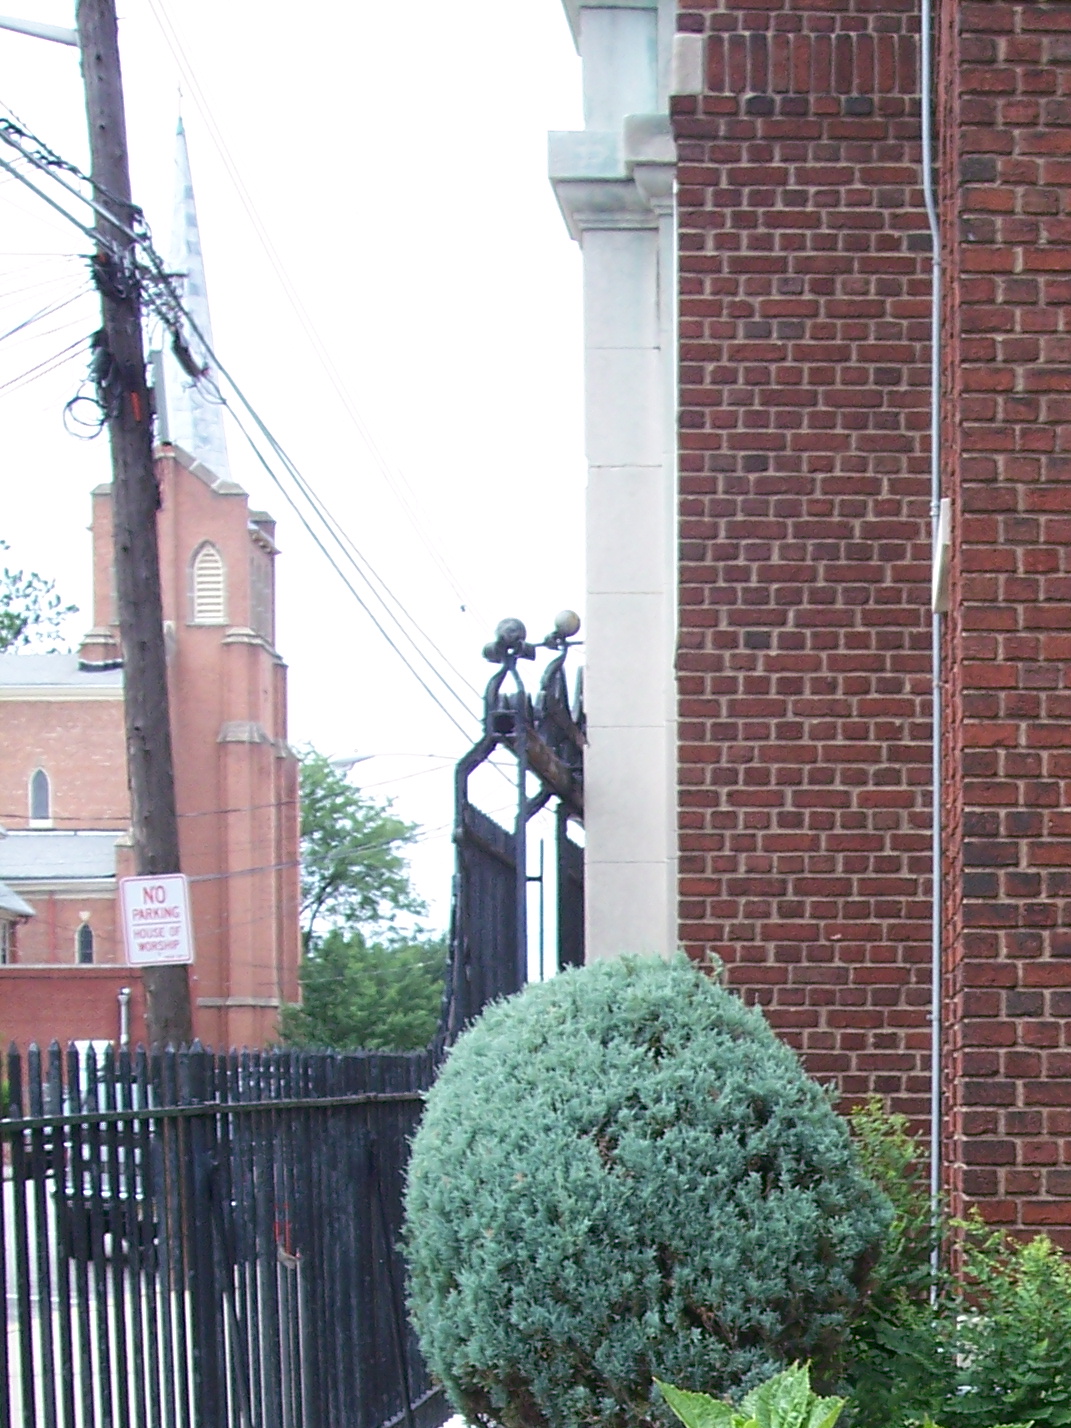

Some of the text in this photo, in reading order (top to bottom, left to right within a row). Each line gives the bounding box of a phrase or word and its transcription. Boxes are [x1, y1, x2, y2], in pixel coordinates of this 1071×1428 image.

[143, 885, 165, 904] NO
[132, 907, 179, 920] PARKING
[133, 925, 181, 939] HOUSE OF
[138, 940, 179, 951] WORSHIP
